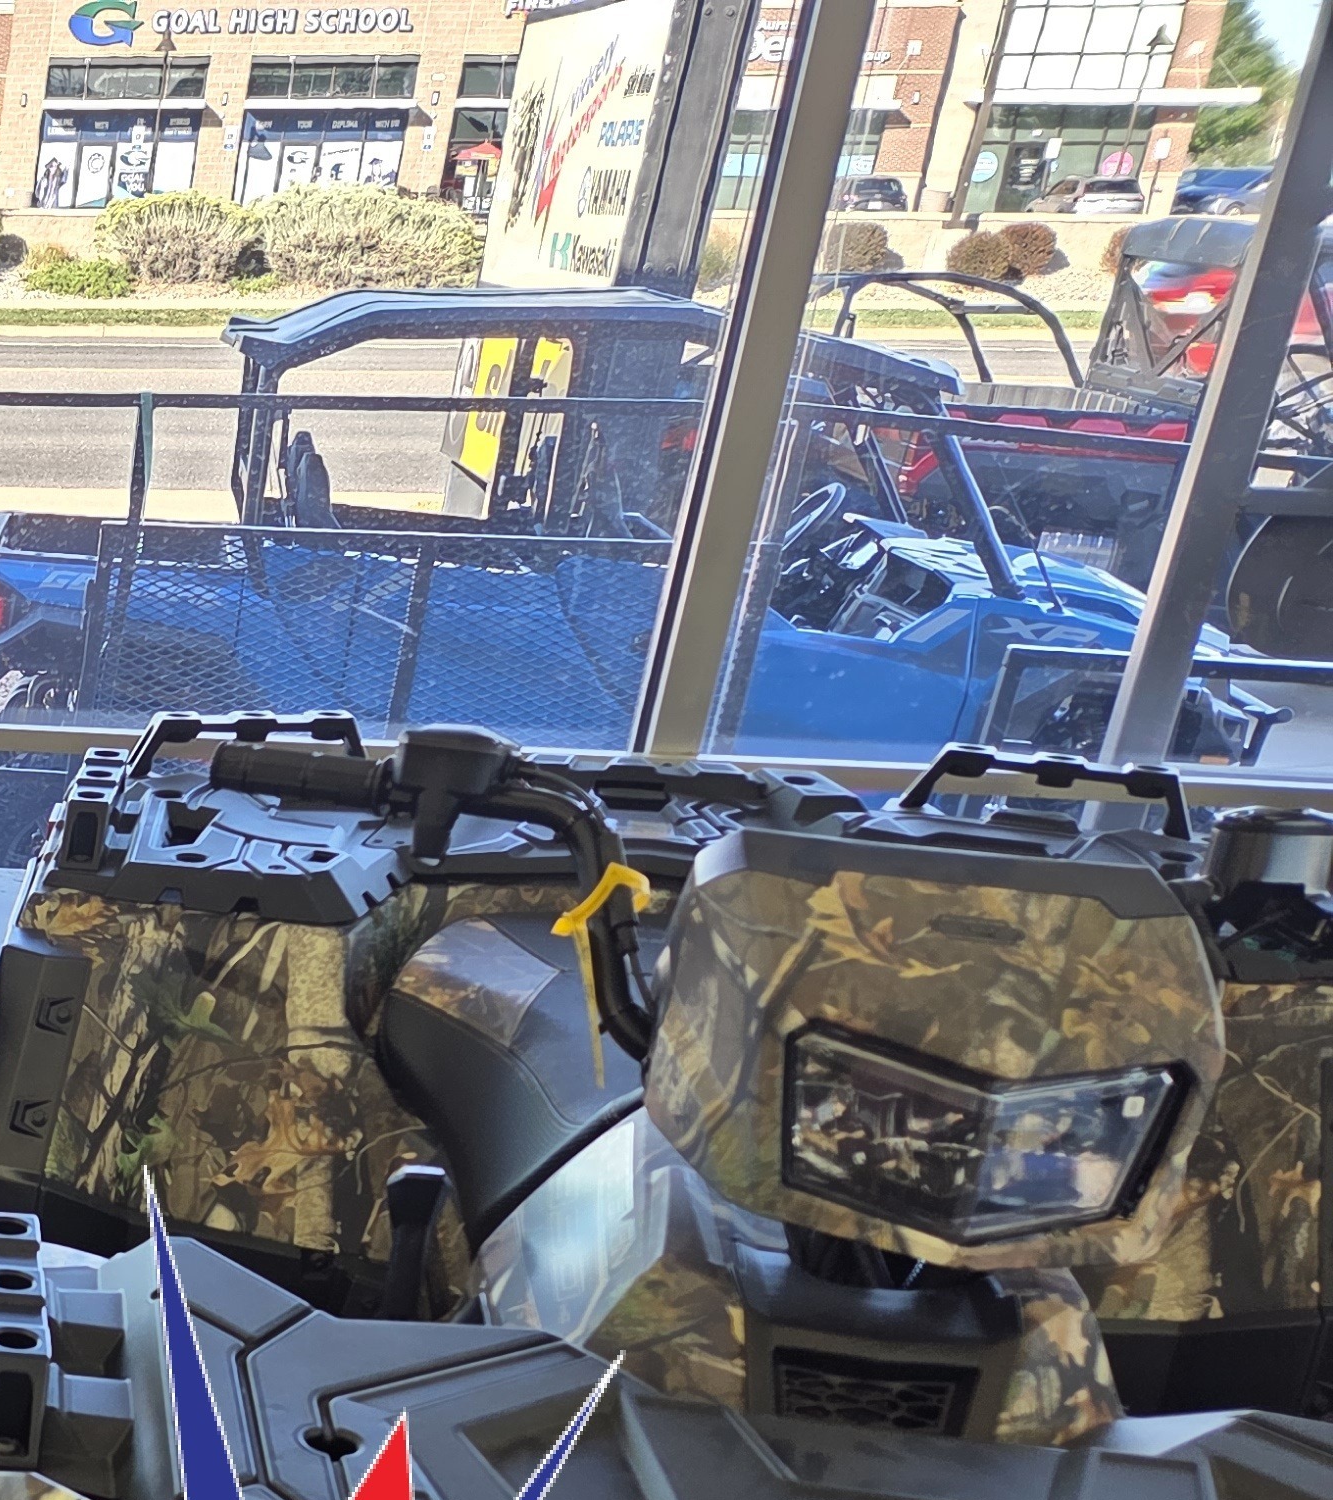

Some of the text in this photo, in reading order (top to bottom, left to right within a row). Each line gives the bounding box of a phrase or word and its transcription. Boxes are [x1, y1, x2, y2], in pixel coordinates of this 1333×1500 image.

[151, 8, 413, 35] GOAL HIGH SCHOOL
[597, 119, 645, 148] POLARIS
[587, 168, 632, 216] YAMAHA
[569, 233, 618, 278] Kawasaki
[986, 616, 1101, 643] XP
